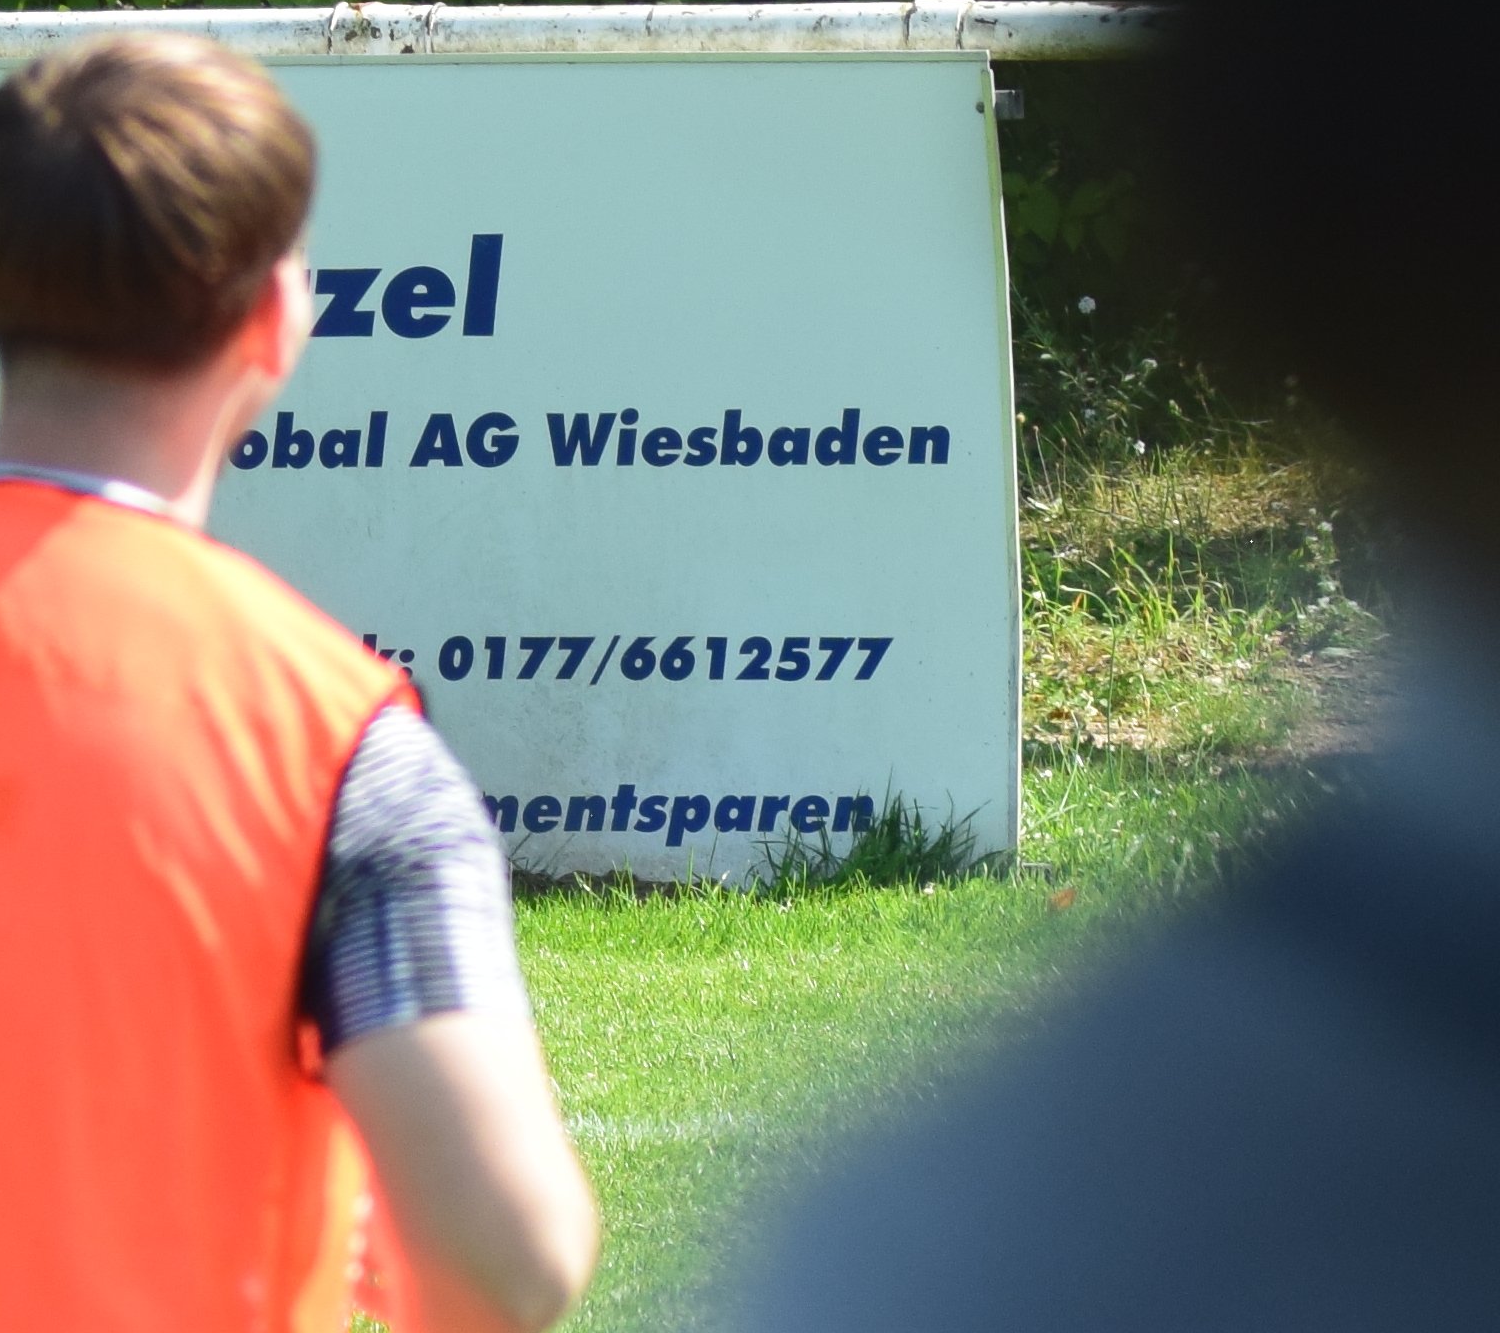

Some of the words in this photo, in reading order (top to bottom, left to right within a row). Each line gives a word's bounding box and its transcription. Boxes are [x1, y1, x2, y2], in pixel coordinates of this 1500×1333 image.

[303, 233, 504, 339] zel
[408, 411, 520, 469] AG
[547, 407, 951, 469] Wiesbaden
[438, 634, 894, 686] 0177/6612577
